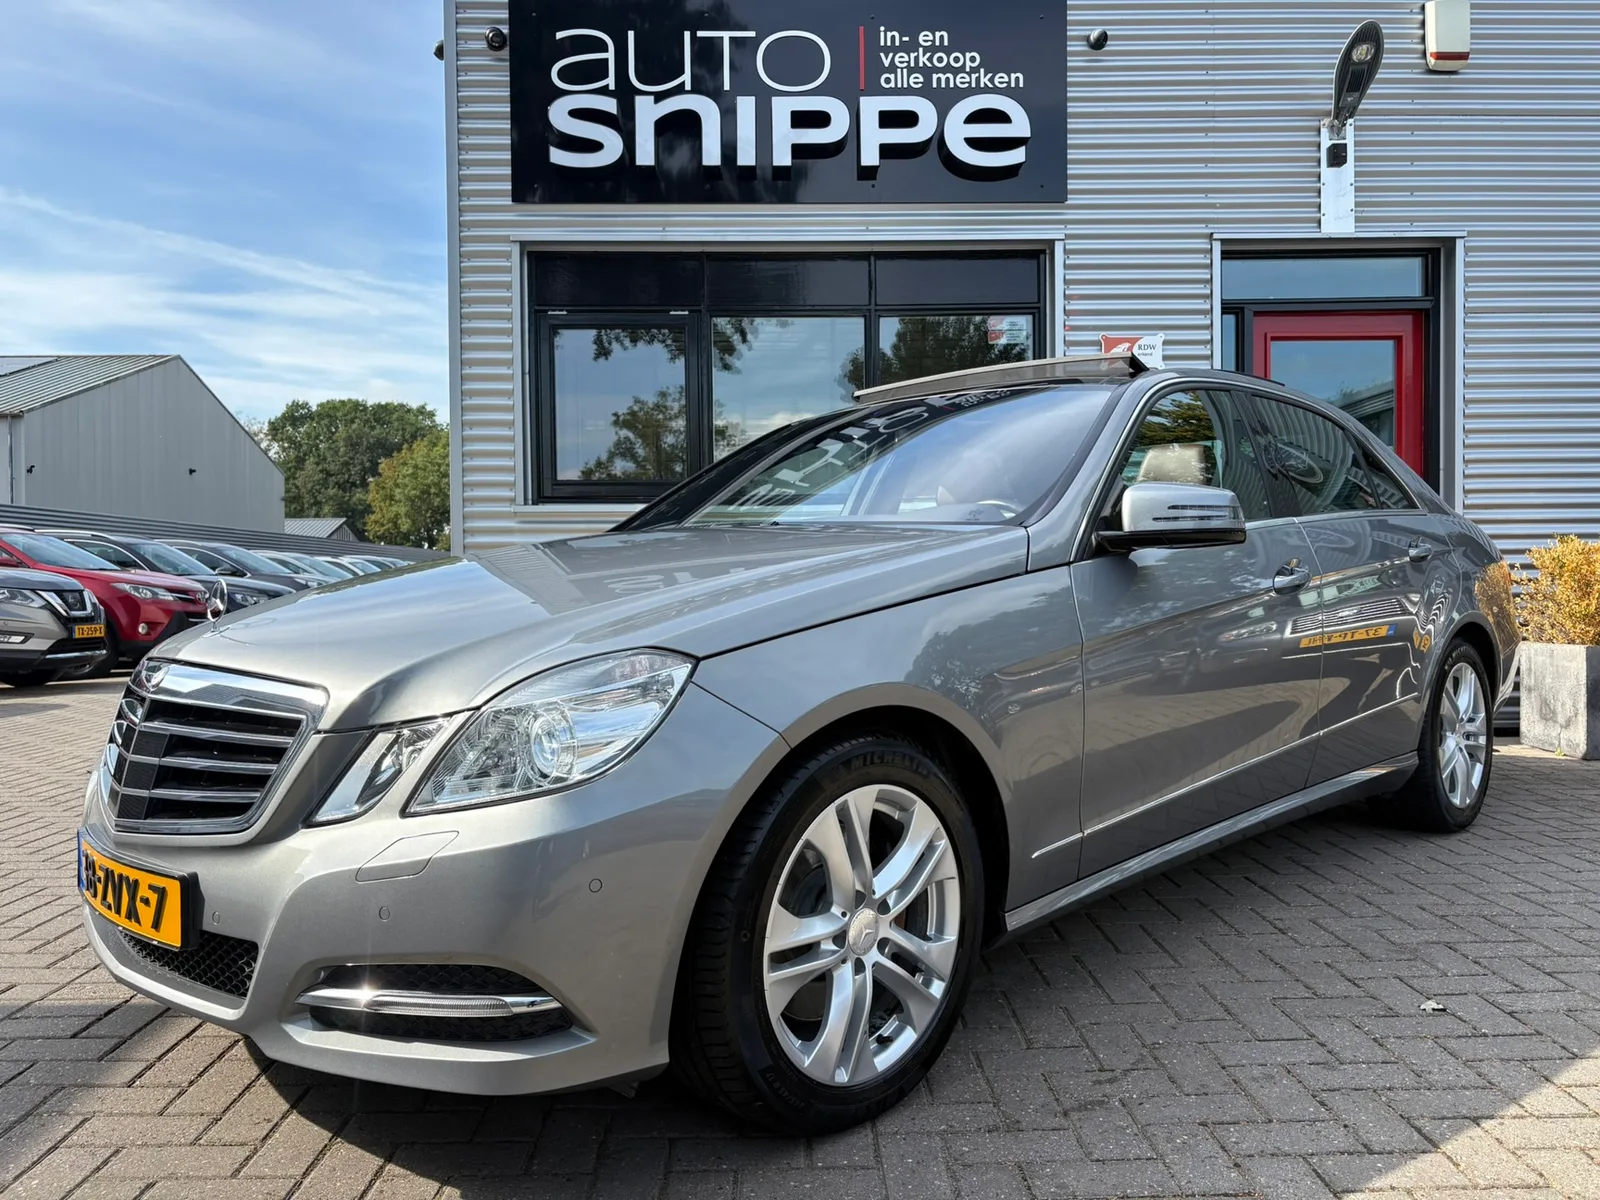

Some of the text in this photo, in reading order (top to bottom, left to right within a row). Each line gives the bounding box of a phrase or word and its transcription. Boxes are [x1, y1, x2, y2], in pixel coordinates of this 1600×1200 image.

[880, 26, 949, 47] in- en
[879, 47, 981, 72] verkoop
[880, 68, 1024, 89] alle merken
[1137, 343, 1157, 351] RDW
[77, 626, 103, 637] TX-259-X
